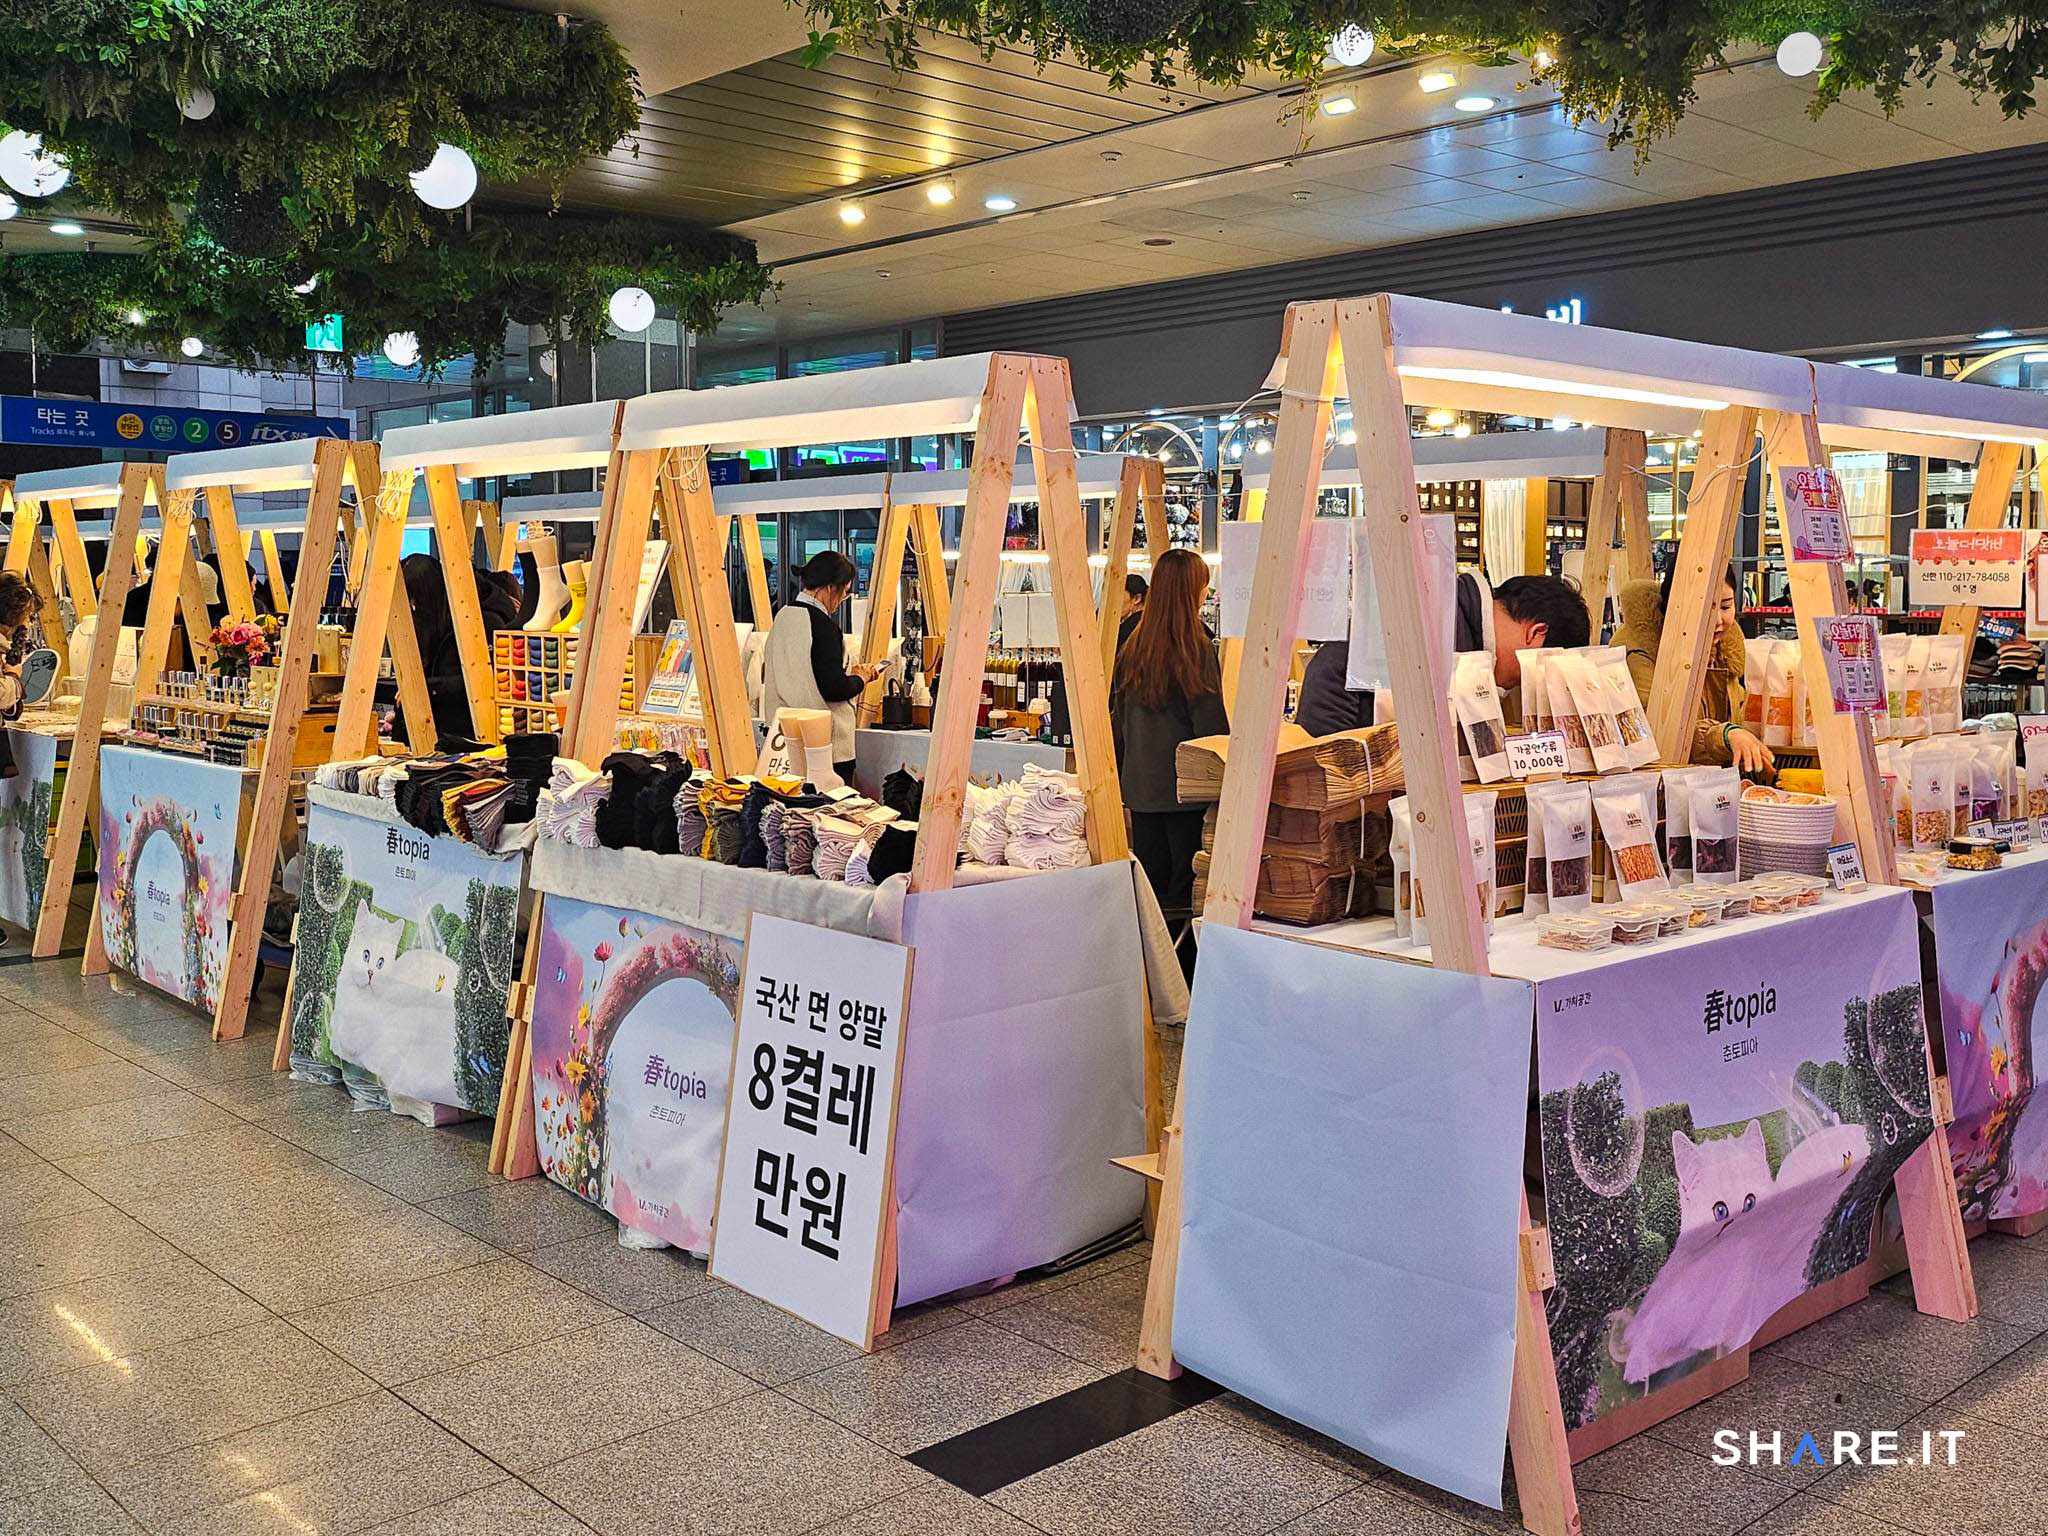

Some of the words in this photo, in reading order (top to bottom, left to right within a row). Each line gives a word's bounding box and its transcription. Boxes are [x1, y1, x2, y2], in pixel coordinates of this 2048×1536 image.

[37, 408, 66, 425] 타는
[75, 411, 89, 426] 곳
[30, 426, 55, 436] Tracks
[191, 422, 202, 438] 2
[222, 424, 234, 440] 5
[1921, 572, 1937, 582] 신한
[1939, 572, 2010, 582] 110-217-784058
[1513, 740, 1558, 755] 가공안주류
[1513, 754, 1565, 770] 10,000원
[386, 825, 430, 864] 春topia
[1837, 866, 1861, 883] 1,000원
[146, 880, 171, 907] 春topia
[755, 975, 801, 1025] 국산
[807, 990, 830, 1034] 면
[838, 999, 887, 1051] 양말
[1703, 980, 1777, 1035] 春topia
[1722, 1036, 1759, 1063] 춘토피아
[643, 1054, 707, 1100] 春topia
[748, 1041, 877, 1156] 8켤레
[649, 1104, 687, 1127] 춘토피아
[753, 1147, 847, 1262] 만원
